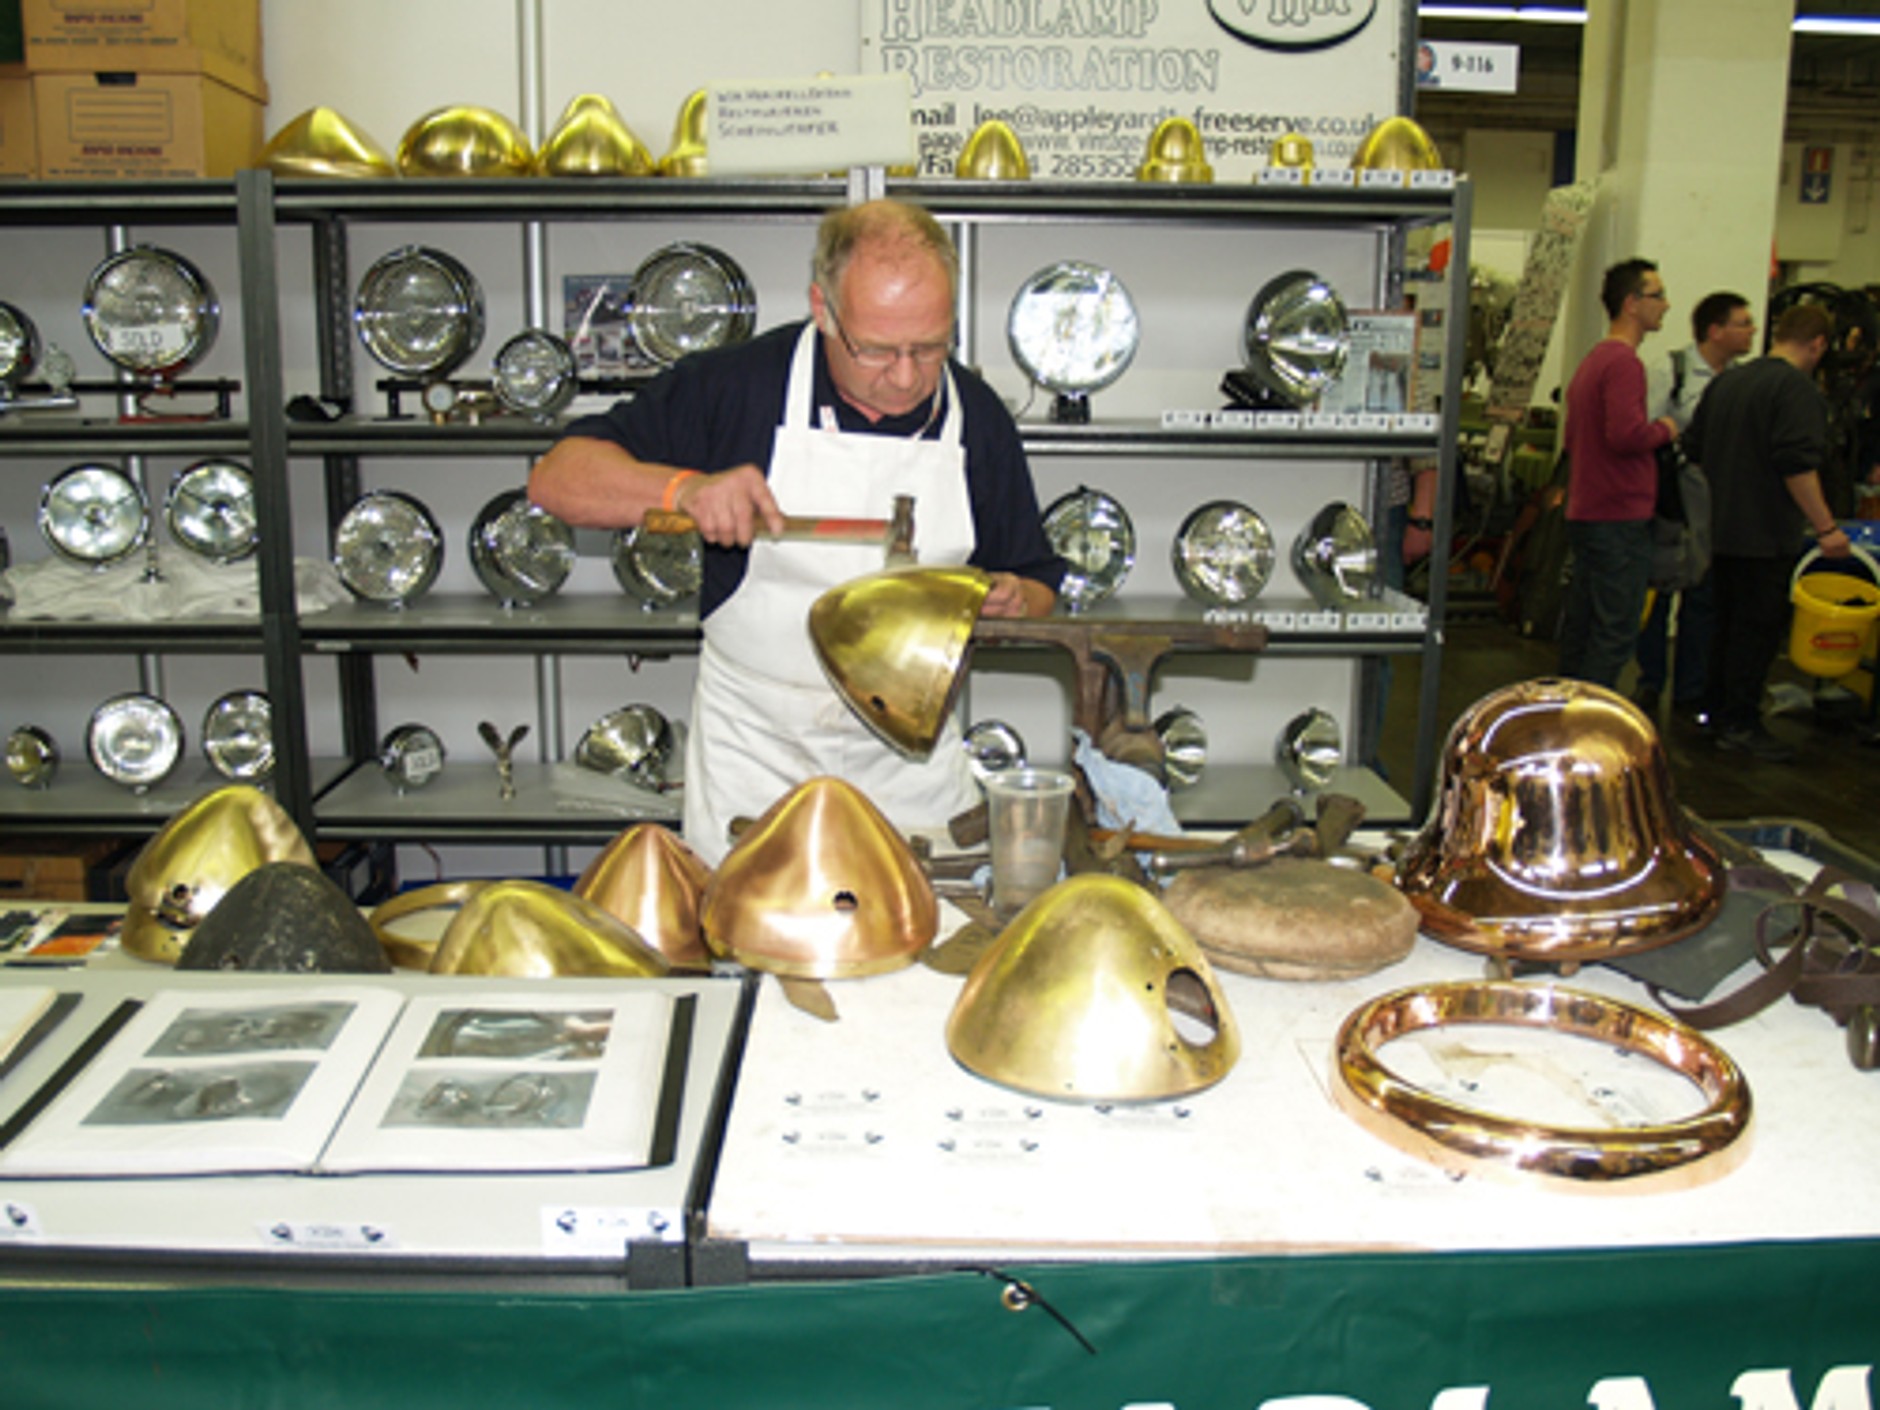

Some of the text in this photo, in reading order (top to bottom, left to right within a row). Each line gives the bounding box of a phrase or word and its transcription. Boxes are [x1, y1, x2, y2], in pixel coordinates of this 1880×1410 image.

[881, 0, 1158, 42] HEADLAMP
[881, 46, 1220, 98] RESTORATION
[1450, 54, 1494, 74] 9-116
